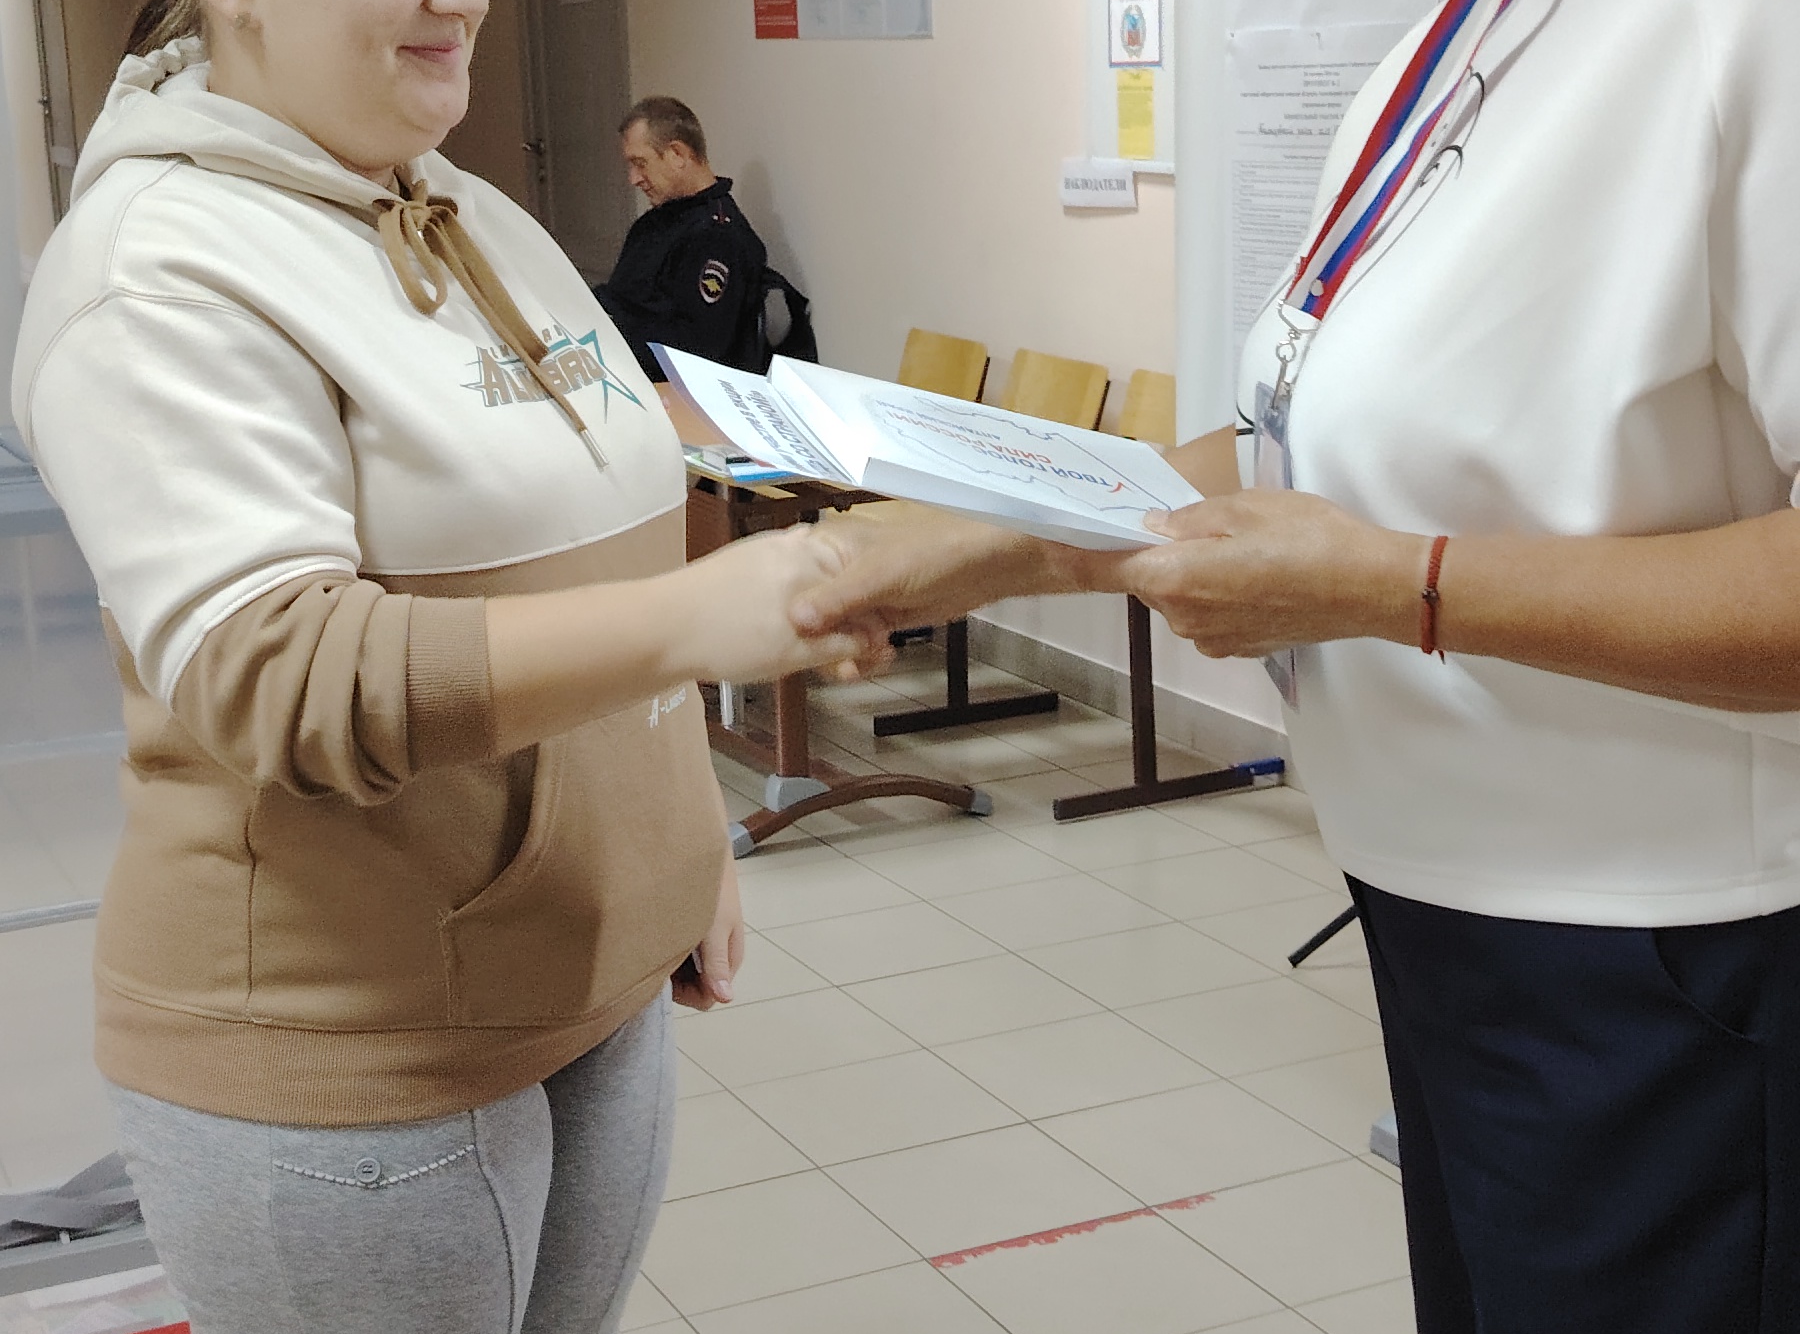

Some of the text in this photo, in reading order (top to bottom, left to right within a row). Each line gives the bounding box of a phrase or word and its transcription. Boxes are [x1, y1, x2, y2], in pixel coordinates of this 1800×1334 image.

[973, 446, 1113, 488] ТВОЙ ГОЛОС
[987, 442, 1053, 465] СИЛА
